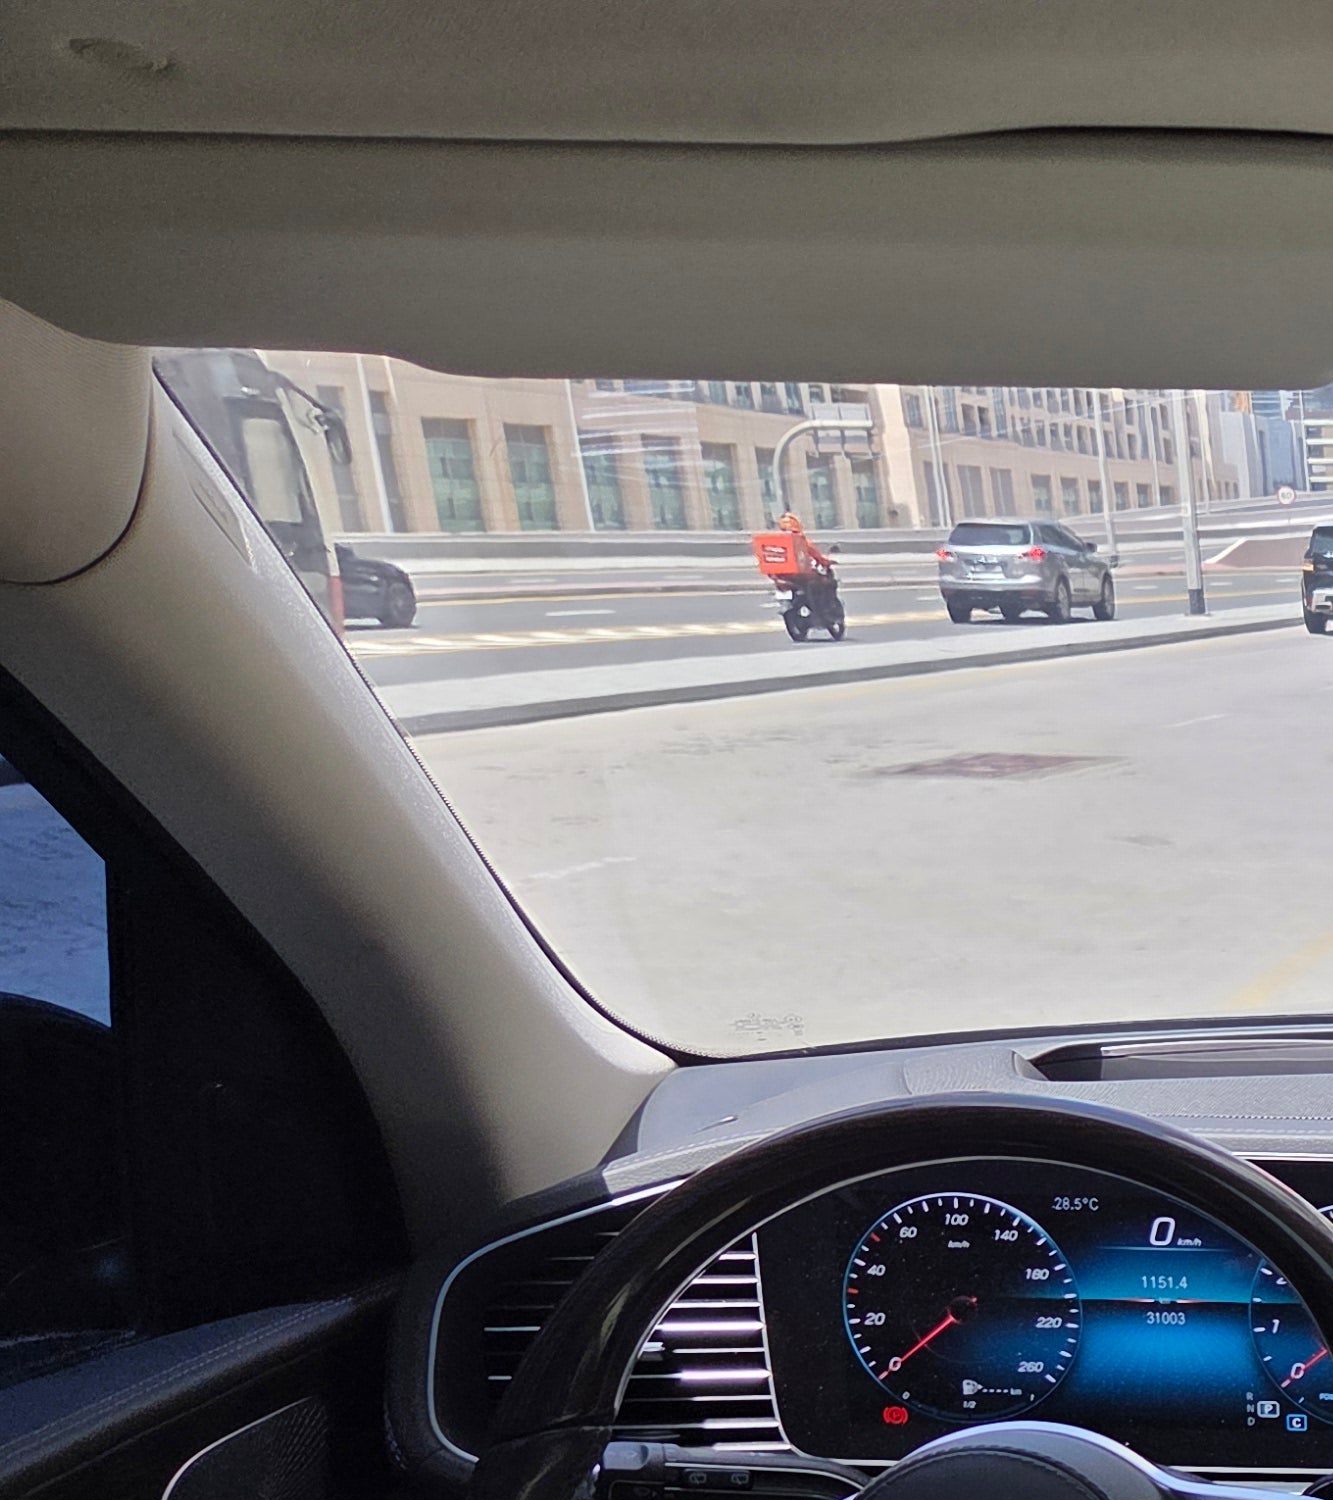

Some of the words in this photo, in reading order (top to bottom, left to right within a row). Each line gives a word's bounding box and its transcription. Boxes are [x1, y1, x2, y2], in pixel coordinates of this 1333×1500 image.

[944, 1213, 969, 1226] 100
[899, 1226, 917, 1239] 60
[993, 1229, 1018, 1241] 140
[1150, 1217, 1176, 1246] 0
[867, 1264, 886, 1276] 40
[1141, 1275, 1188, 1289] 1151.4
[864, 1312, 886, 1326] 20
[1035, 1317, 1062, 1328] 220
[1146, 1311, 1186, 1325] 31003
[1271, 1319, 1280, 1334] 1
[1017, 1361, 1044, 1373] 260
[1291, 1417, 1302, 1428] C
